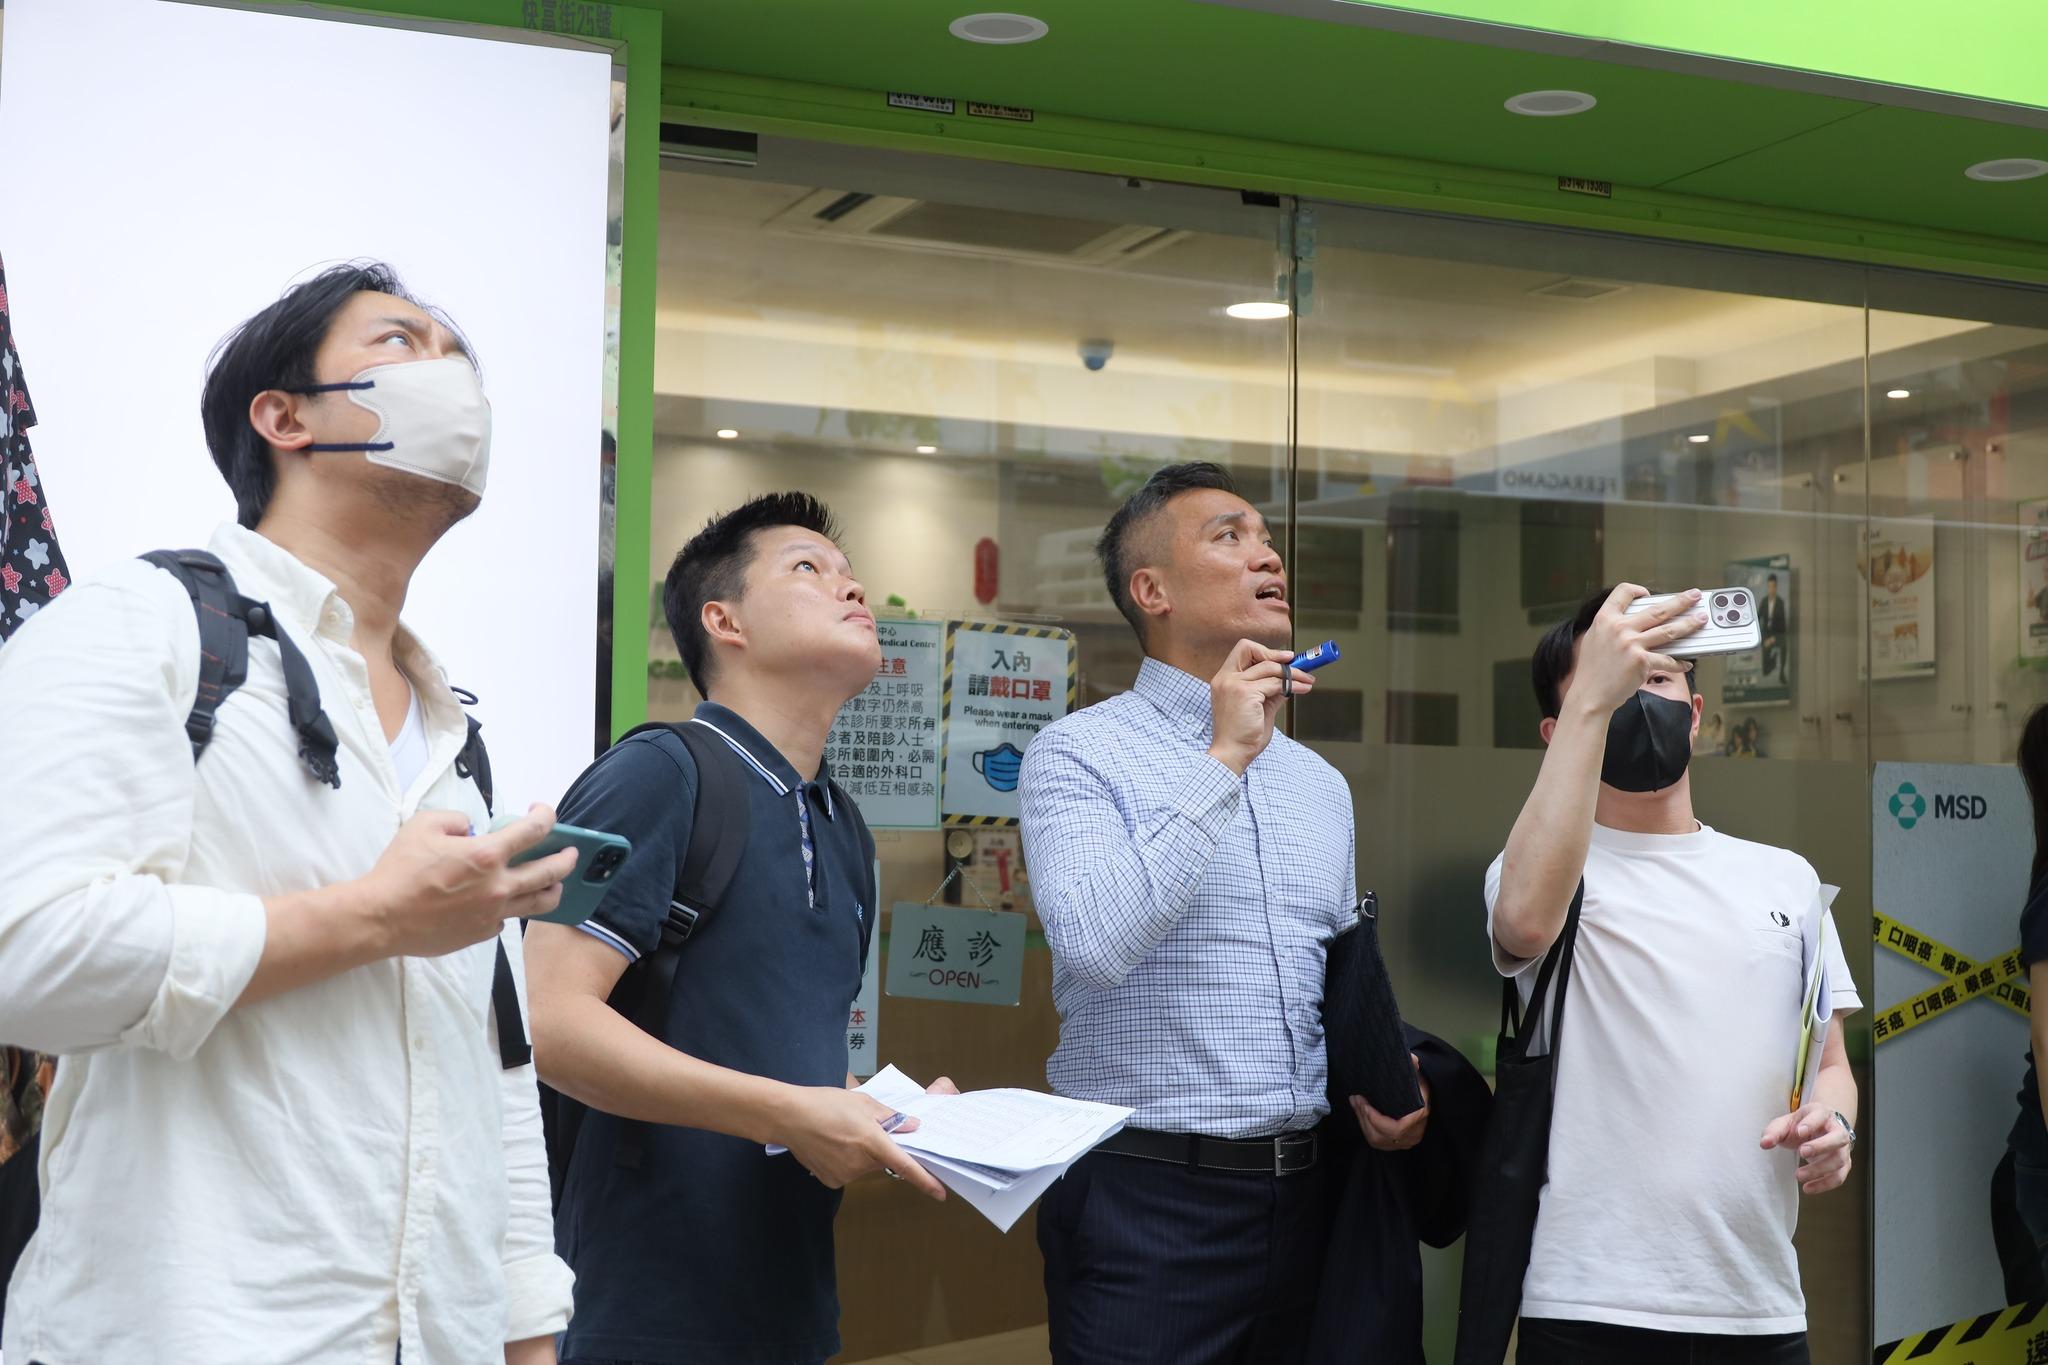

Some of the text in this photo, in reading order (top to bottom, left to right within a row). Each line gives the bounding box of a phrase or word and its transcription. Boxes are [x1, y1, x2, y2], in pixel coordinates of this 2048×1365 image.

[910, 639, 937, 649] Centre
[991, 649, 1031, 672] 入內
[968, 673, 1051, 702] 請戴口罩
[836, 714, 936, 731] 本診所要求所有
[964, 705, 1053, 721] Please wear a mask
[975, 718, 1000, 728] when
[1934, 794, 1987, 819] MSD
[1888, 926, 1934, 961] 口咽癌
[928, 968, 981, 989] OPEN
[1874, 1010, 1904, 1039] 舌癌
[1912, 985, 1958, 1020] 口咽癌
[1964, 967, 1996, 994] 喉癌
[849, 1008, 867, 1025] 本
